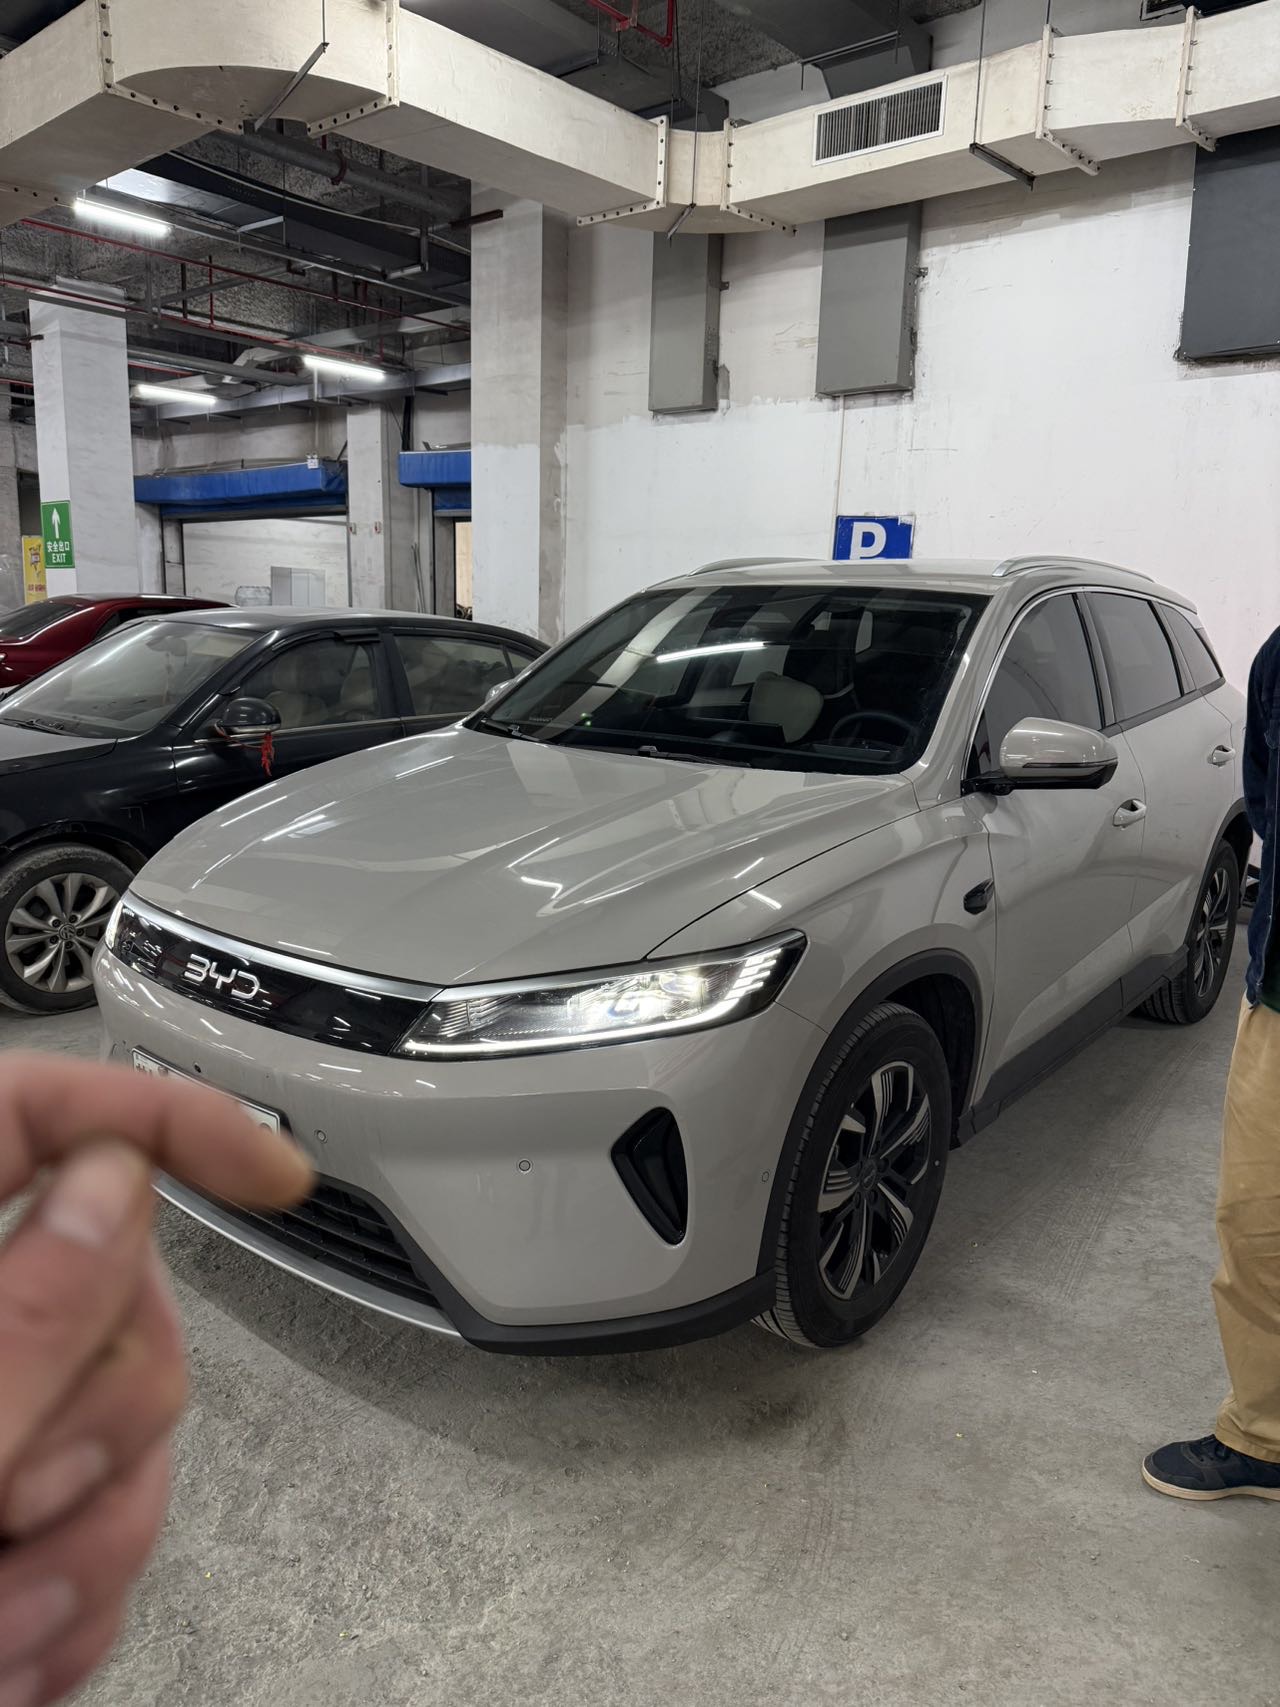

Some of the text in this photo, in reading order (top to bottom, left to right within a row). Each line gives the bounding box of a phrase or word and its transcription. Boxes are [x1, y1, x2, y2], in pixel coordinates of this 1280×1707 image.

[46, 541, 70, 553] 安全出口
[850, 521, 886, 560] P
[52, 553, 66, 563] EXIT
[184, 953, 260, 999] BYD
